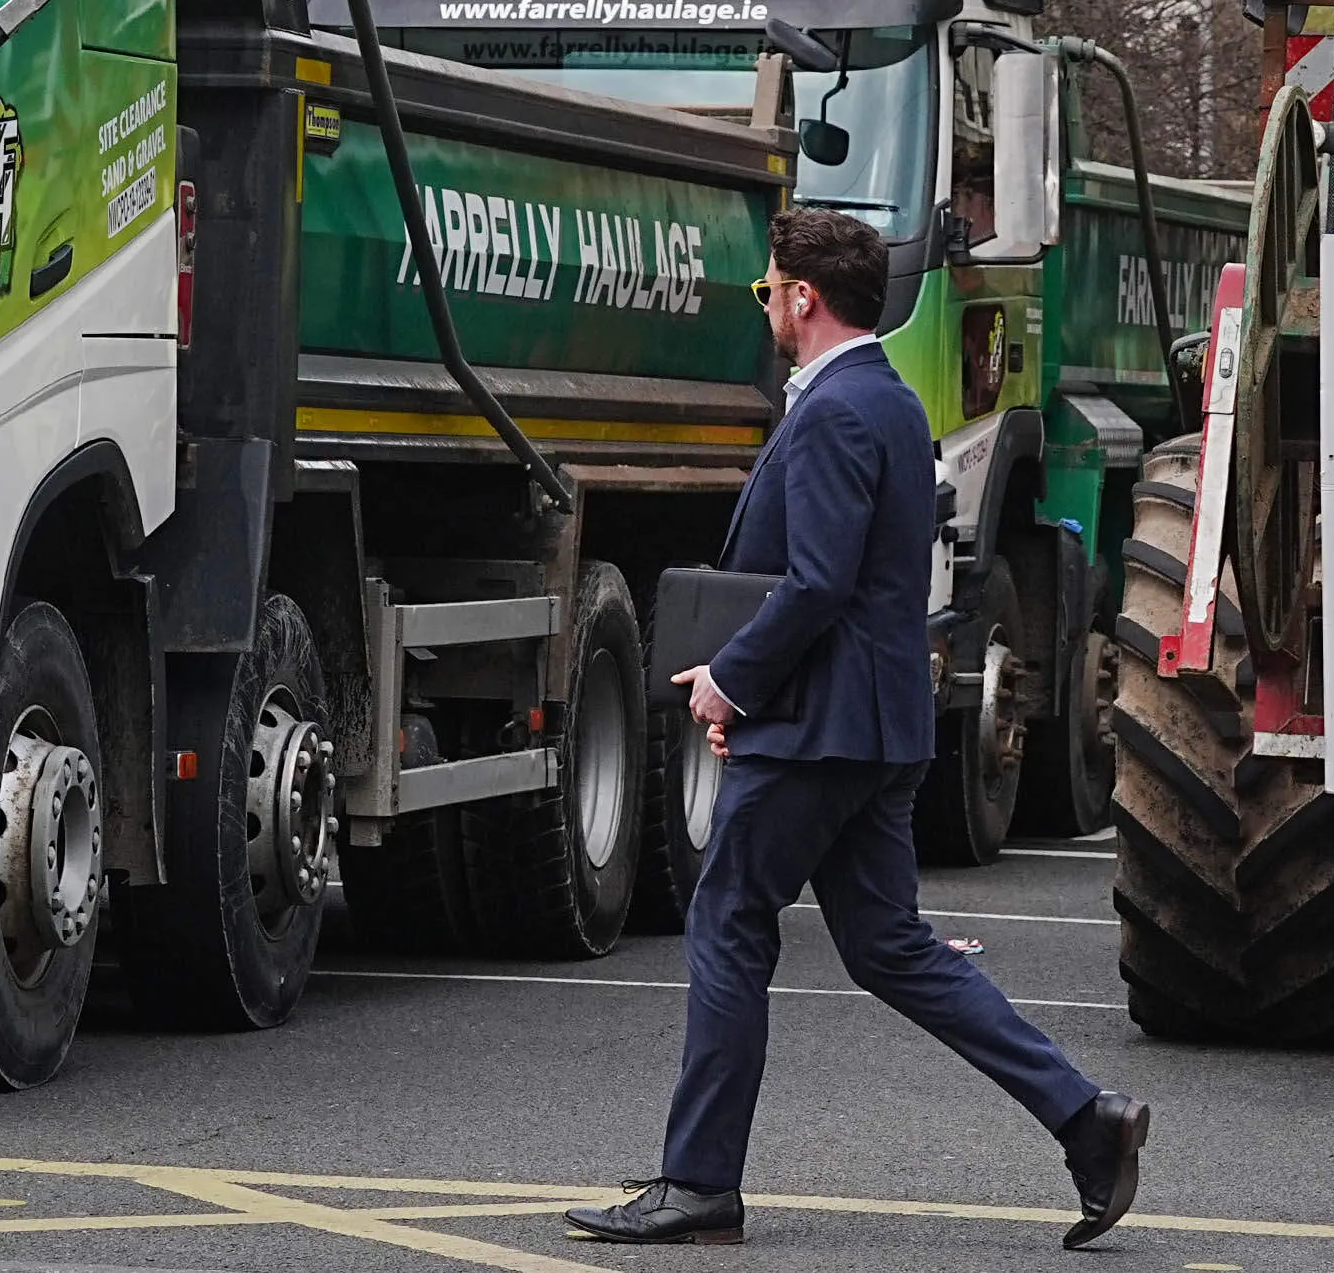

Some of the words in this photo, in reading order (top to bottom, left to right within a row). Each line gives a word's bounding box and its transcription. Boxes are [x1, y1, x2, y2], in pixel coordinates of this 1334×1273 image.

[98, 115, 120, 155] SITE
[119, 79, 167, 139] CLEARANCE
[101, 156, 127, 198] SAND
[127, 149, 135, 178] &
[135, 124, 166, 171] GRAVEL
[573, 208, 705, 315] HAULAGE
